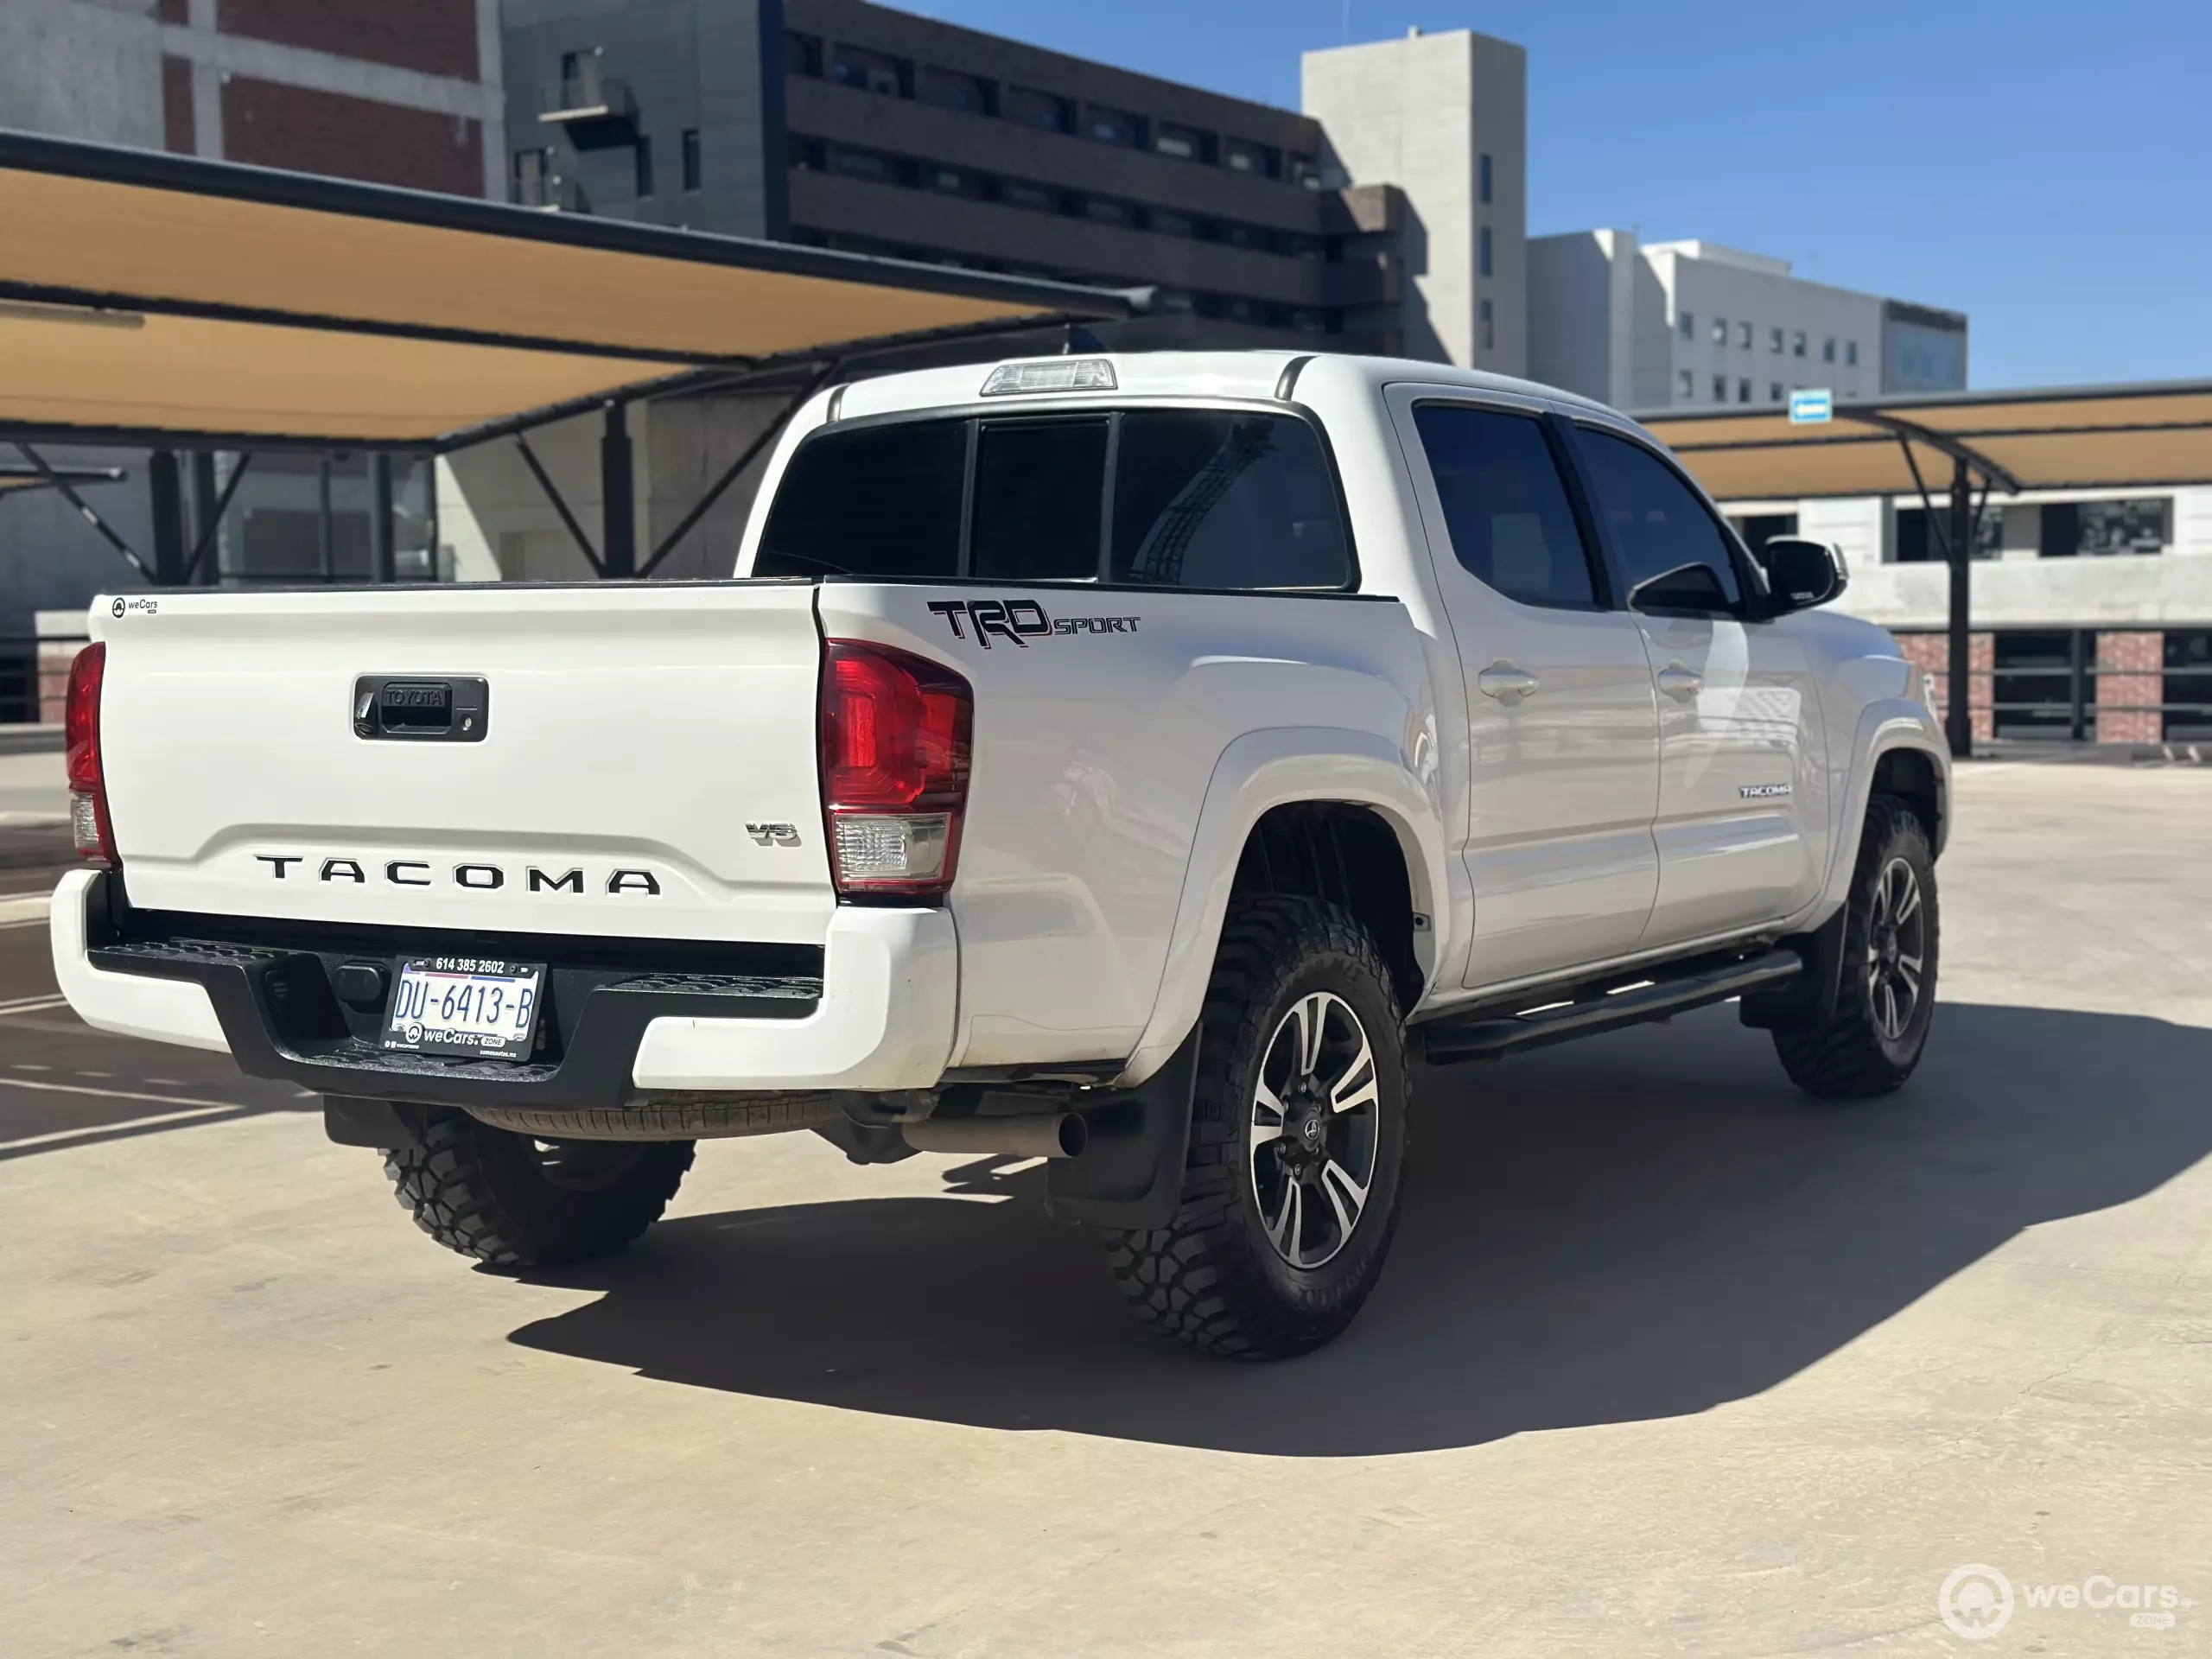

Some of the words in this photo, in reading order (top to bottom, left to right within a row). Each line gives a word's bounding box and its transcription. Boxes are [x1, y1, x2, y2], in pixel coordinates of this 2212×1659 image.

[129, 599, 158, 609] weCars
[927, 600, 1053, 649] TRD
[1053, 617, 1141, 635] SPORT
[386, 690, 443, 705] TOYOTA
[1738, 784, 1792, 798] TACOMA
[744, 823, 798, 840] V6
[254, 854, 662, 896] TACOMA
[435, 957, 455, 970] 614
[457, 958, 476, 972] 385
[478, 960, 505, 974] 2602
[395, 979, 533, 1028] DU-6413-B
[484, 1037, 502, 1046] ZONE
